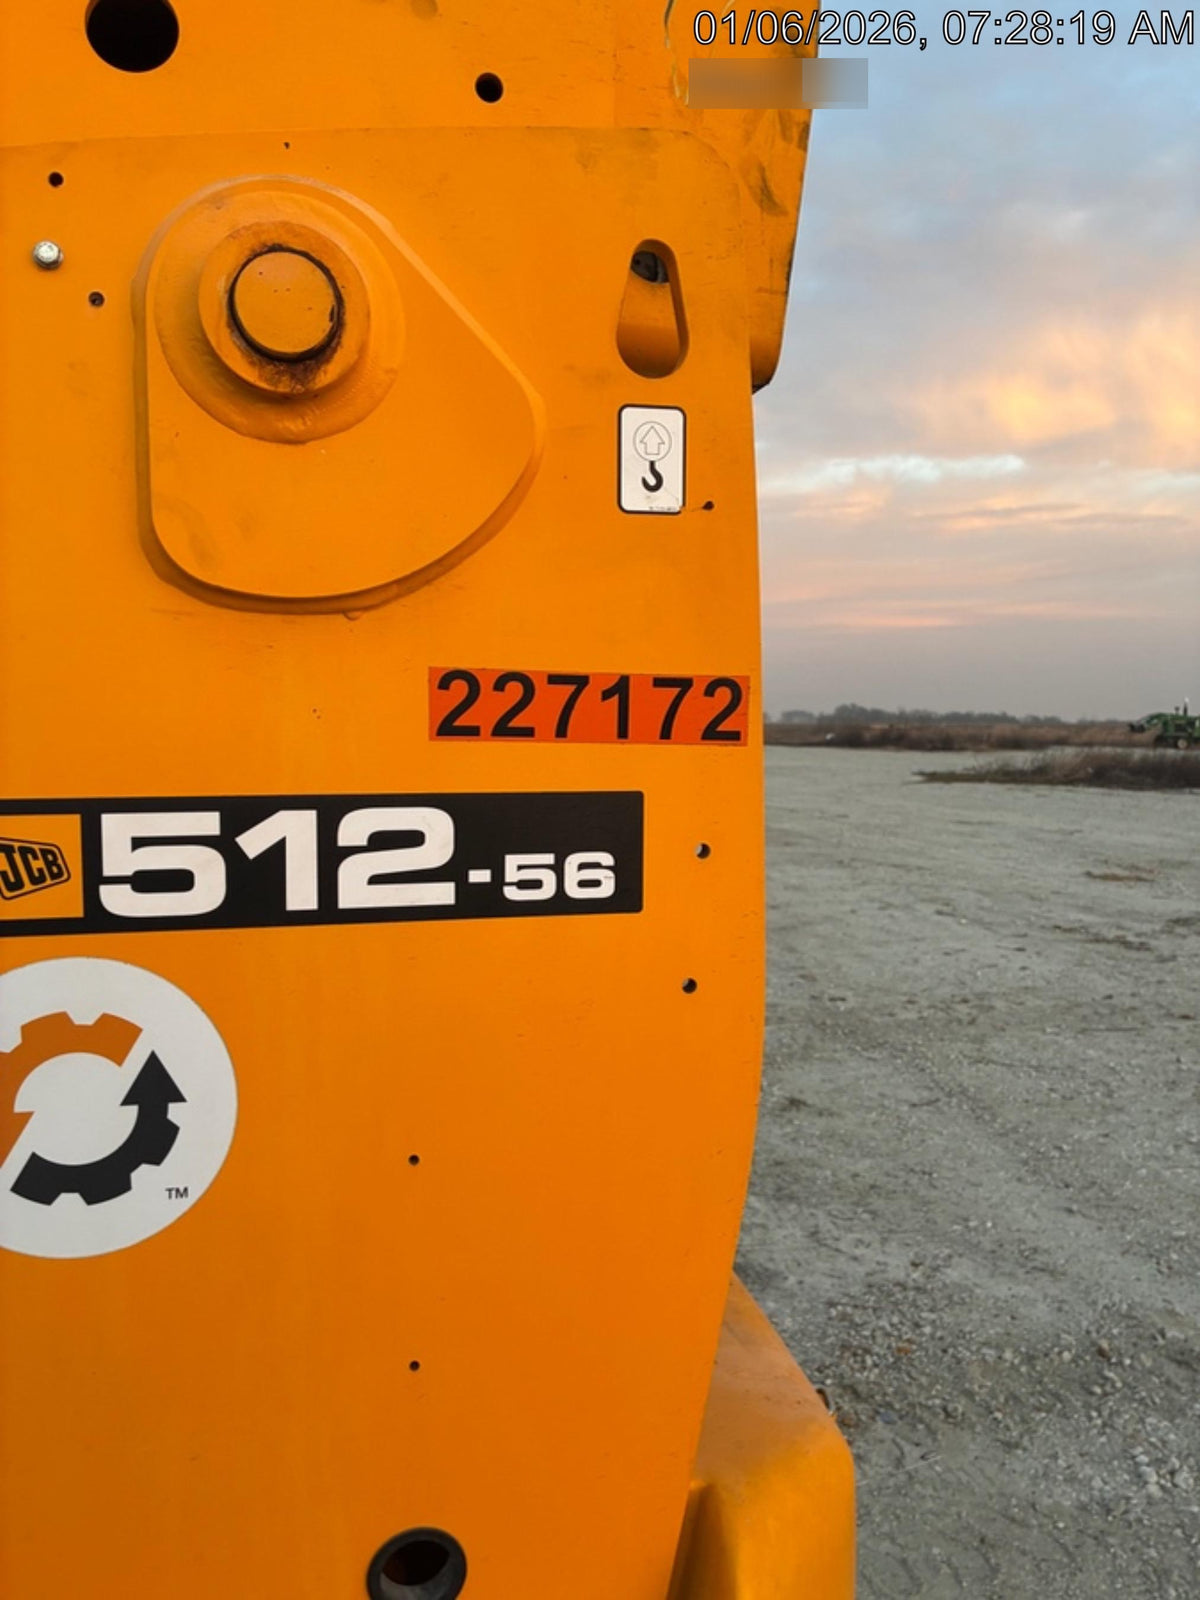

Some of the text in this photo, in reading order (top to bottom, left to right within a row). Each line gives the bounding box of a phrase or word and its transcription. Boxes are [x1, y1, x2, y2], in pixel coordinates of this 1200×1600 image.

[436, 670, 744, 742] 227172
[0, 843, 64, 893] JCB
[165, 1187, 189, 1200] TM
